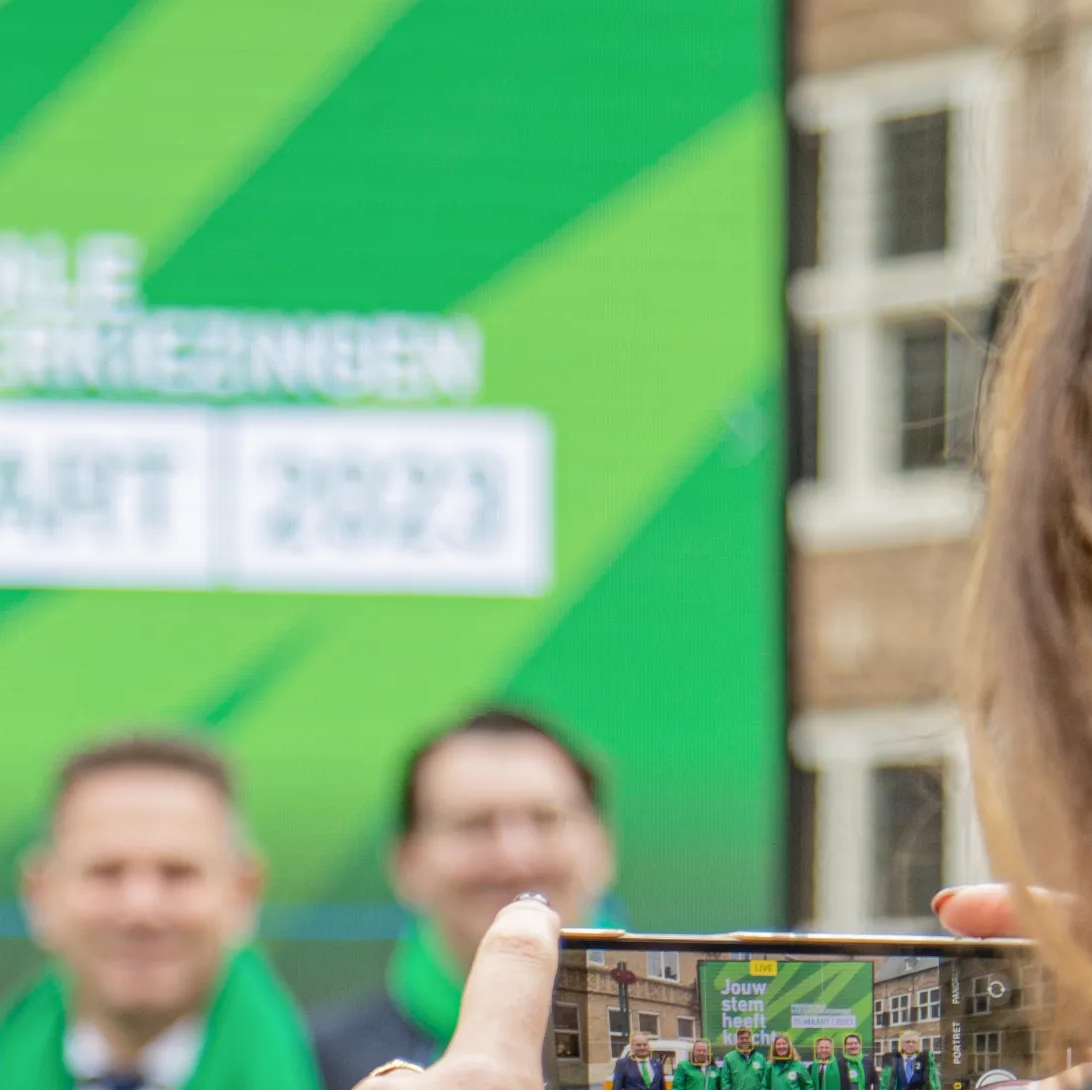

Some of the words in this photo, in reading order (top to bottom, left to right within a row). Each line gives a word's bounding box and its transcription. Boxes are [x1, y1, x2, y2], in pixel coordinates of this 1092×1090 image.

[258, 452, 508, 560] 2023
[754, 964, 773, 973] LIVE
[720, 978, 767, 995] Jouw
[721, 996, 764, 1012] stem
[722, 1012, 766, 1029] heeft
[952, 1021, 962, 1065] PORTRET
[915, 1062, 921, 1070] 2
